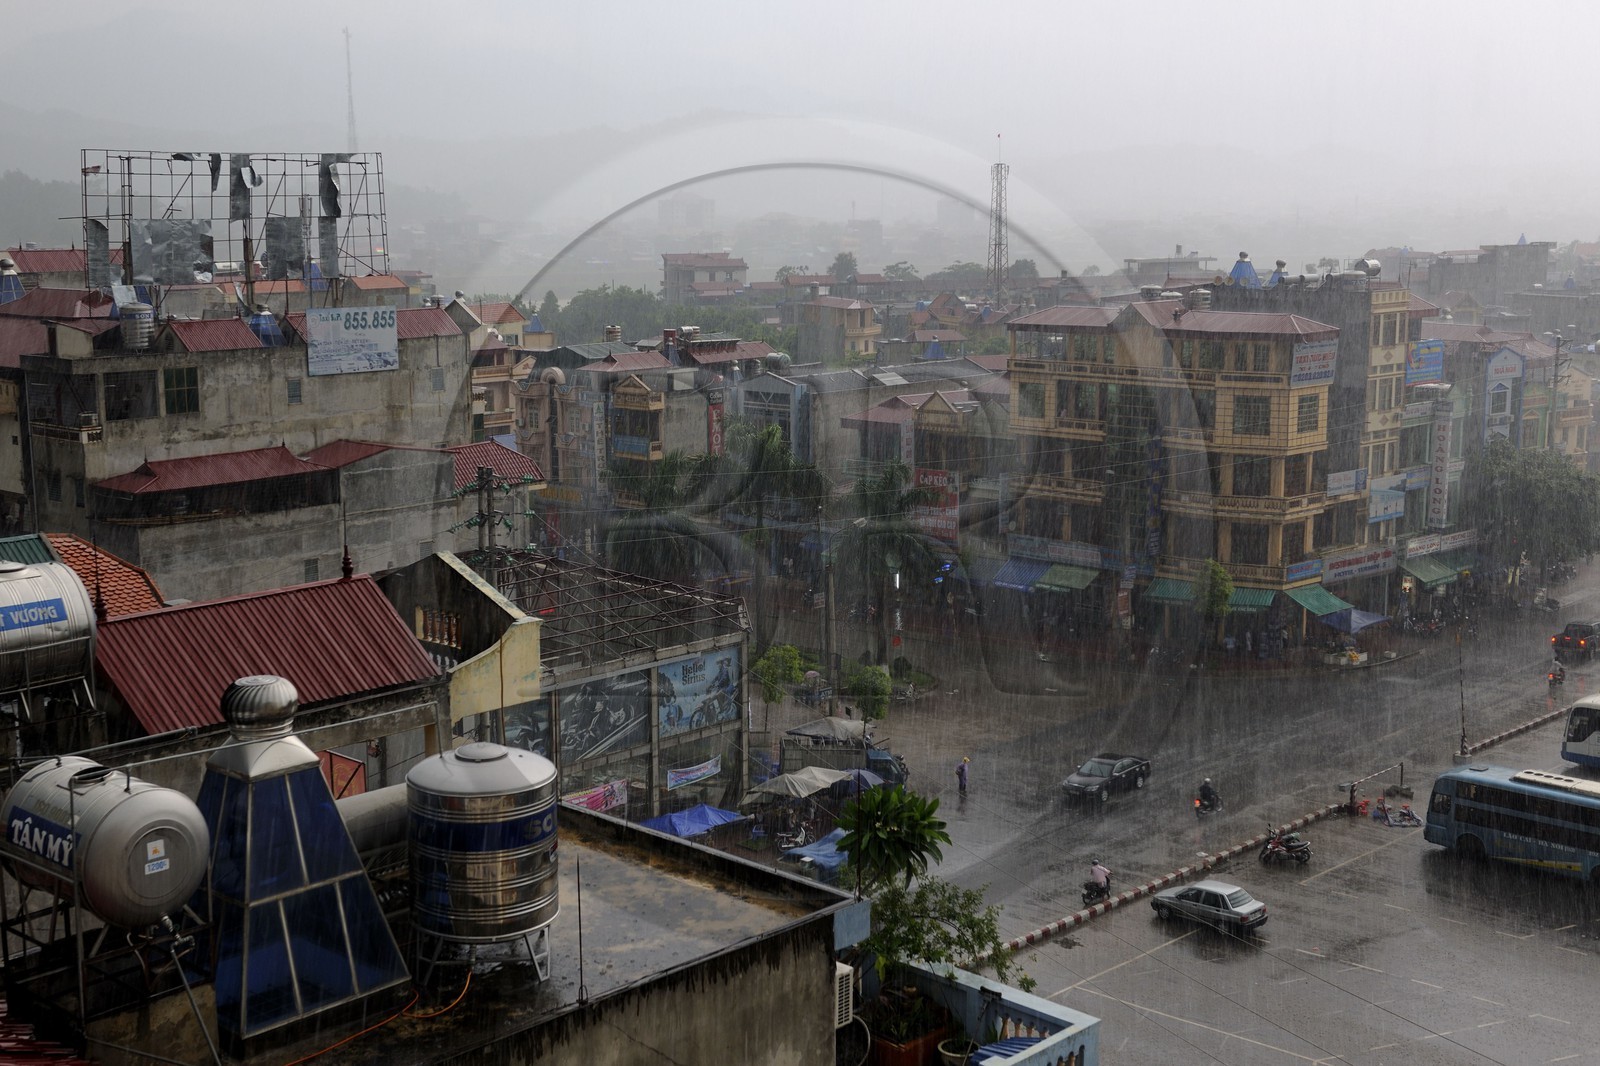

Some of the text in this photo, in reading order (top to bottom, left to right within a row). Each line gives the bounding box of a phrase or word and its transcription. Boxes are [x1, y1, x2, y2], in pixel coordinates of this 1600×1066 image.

[343, 310, 395, 331] 855.855
[1431, 477, 1442, 515] LONG
[1334, 568, 1354, 578] HOTEL
[9, 605, 58, 625] VƯƠNG
[682, 659, 706, 676] Hello!
[682, 673, 706, 686] Sirius
[11, 816, 47, 855] TÂN
